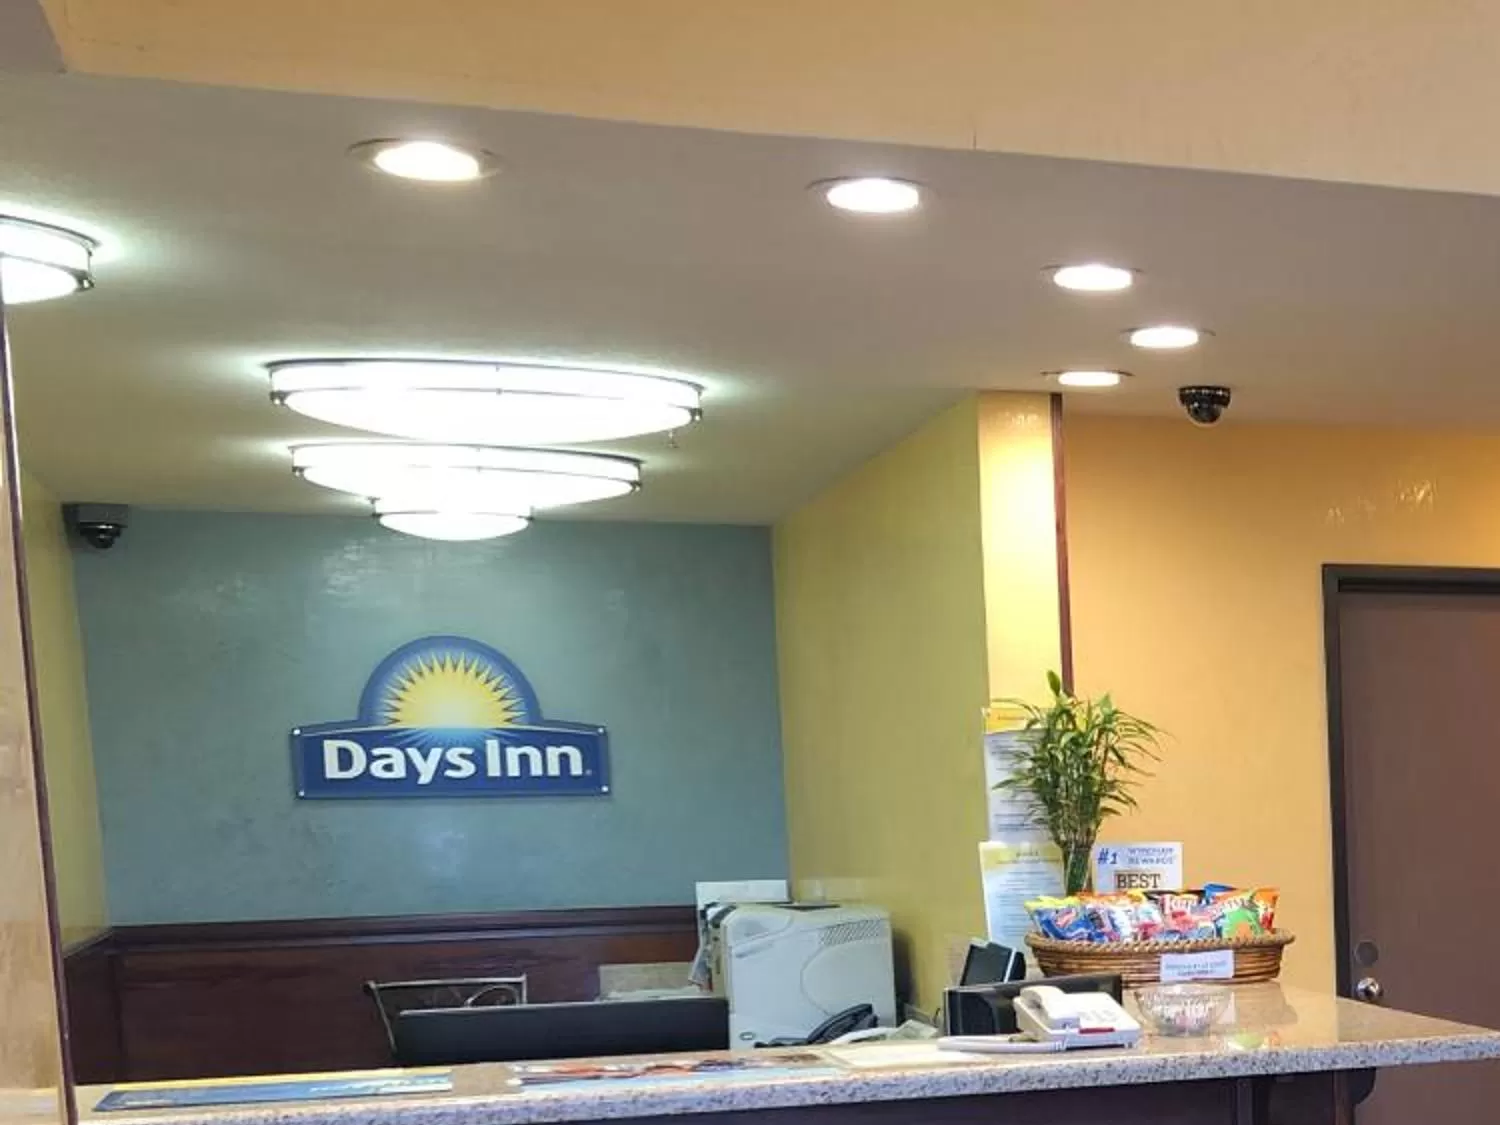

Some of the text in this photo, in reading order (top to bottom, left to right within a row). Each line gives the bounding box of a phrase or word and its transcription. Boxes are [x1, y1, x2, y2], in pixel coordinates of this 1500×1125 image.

[323, 739, 584, 785] Days Inn
[1098, 848, 1118, 865] #1
[1115, 873, 1161, 889] BEST
